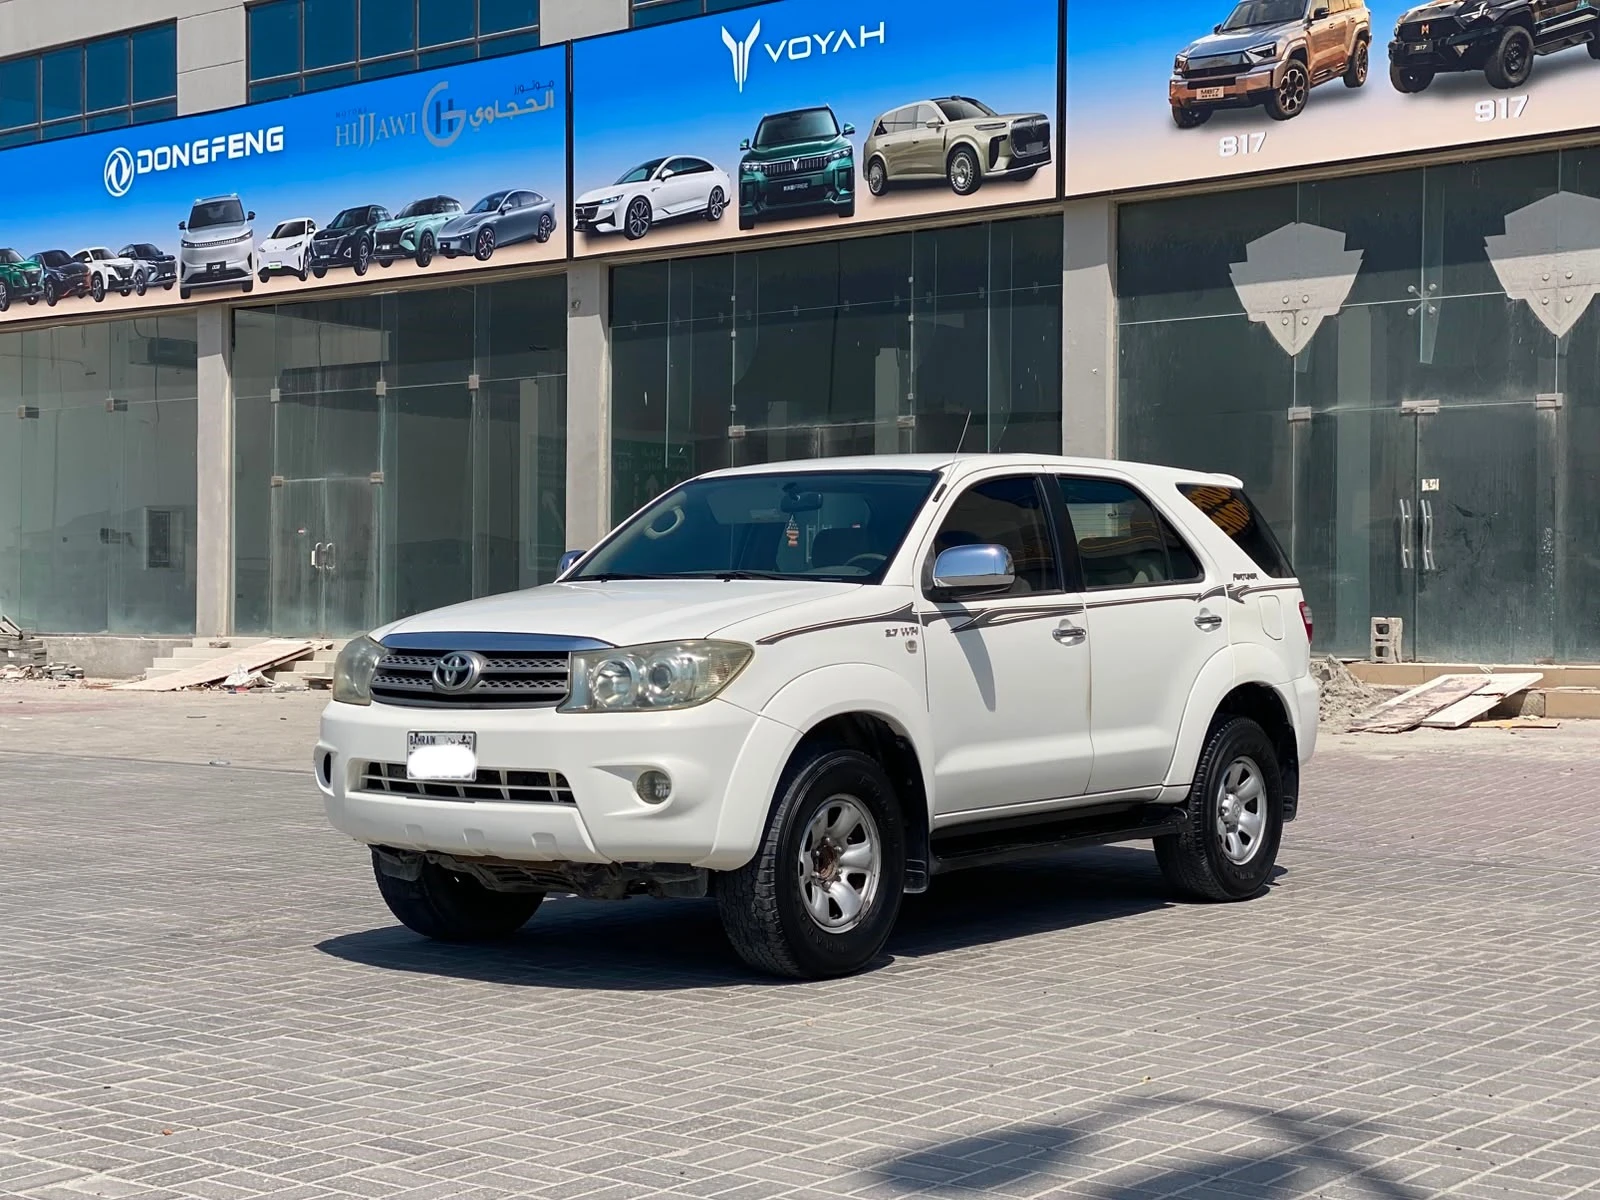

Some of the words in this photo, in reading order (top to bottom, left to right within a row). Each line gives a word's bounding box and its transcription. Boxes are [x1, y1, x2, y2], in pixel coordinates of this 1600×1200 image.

[764, 21, 885, 63] VOYAH
[469, 89, 554, 132] الحجاوي
[1475, 95, 1529, 122] 917
[137, 125, 284, 174] DONGFENG
[335, 112, 417, 149] HIJJAWI
[1219, 131, 1267, 157] 817
